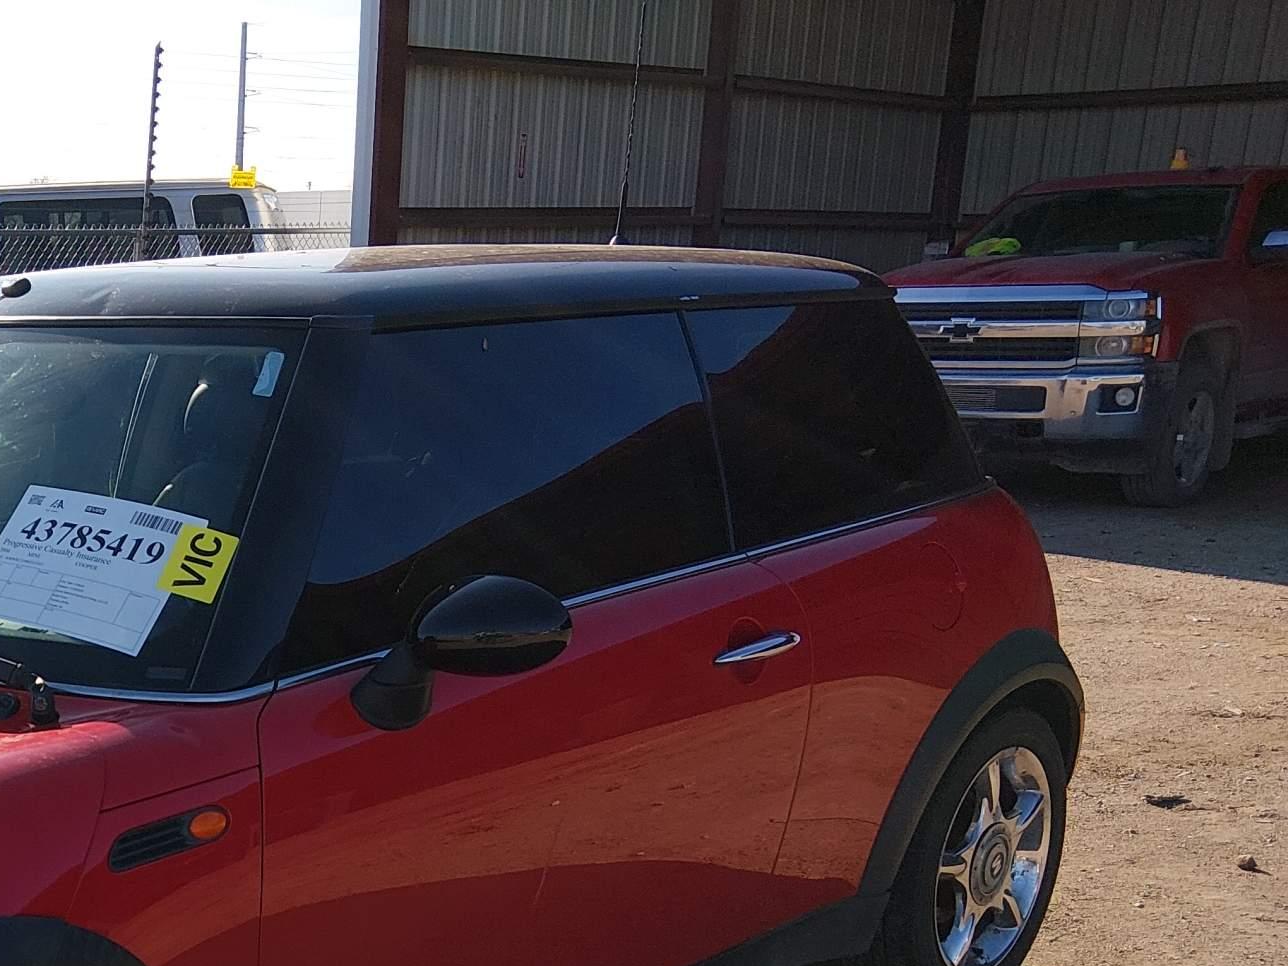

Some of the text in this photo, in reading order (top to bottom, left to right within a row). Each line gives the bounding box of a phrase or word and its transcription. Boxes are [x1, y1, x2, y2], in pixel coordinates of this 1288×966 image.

[2, 539, 43, 552] Progressive
[44, 544, 73, 558] Casualty
[76, 552, 112, 566] Insurance
[20, 517, 165, 564] 43785419
[172, 533, 222, 587] VIC
